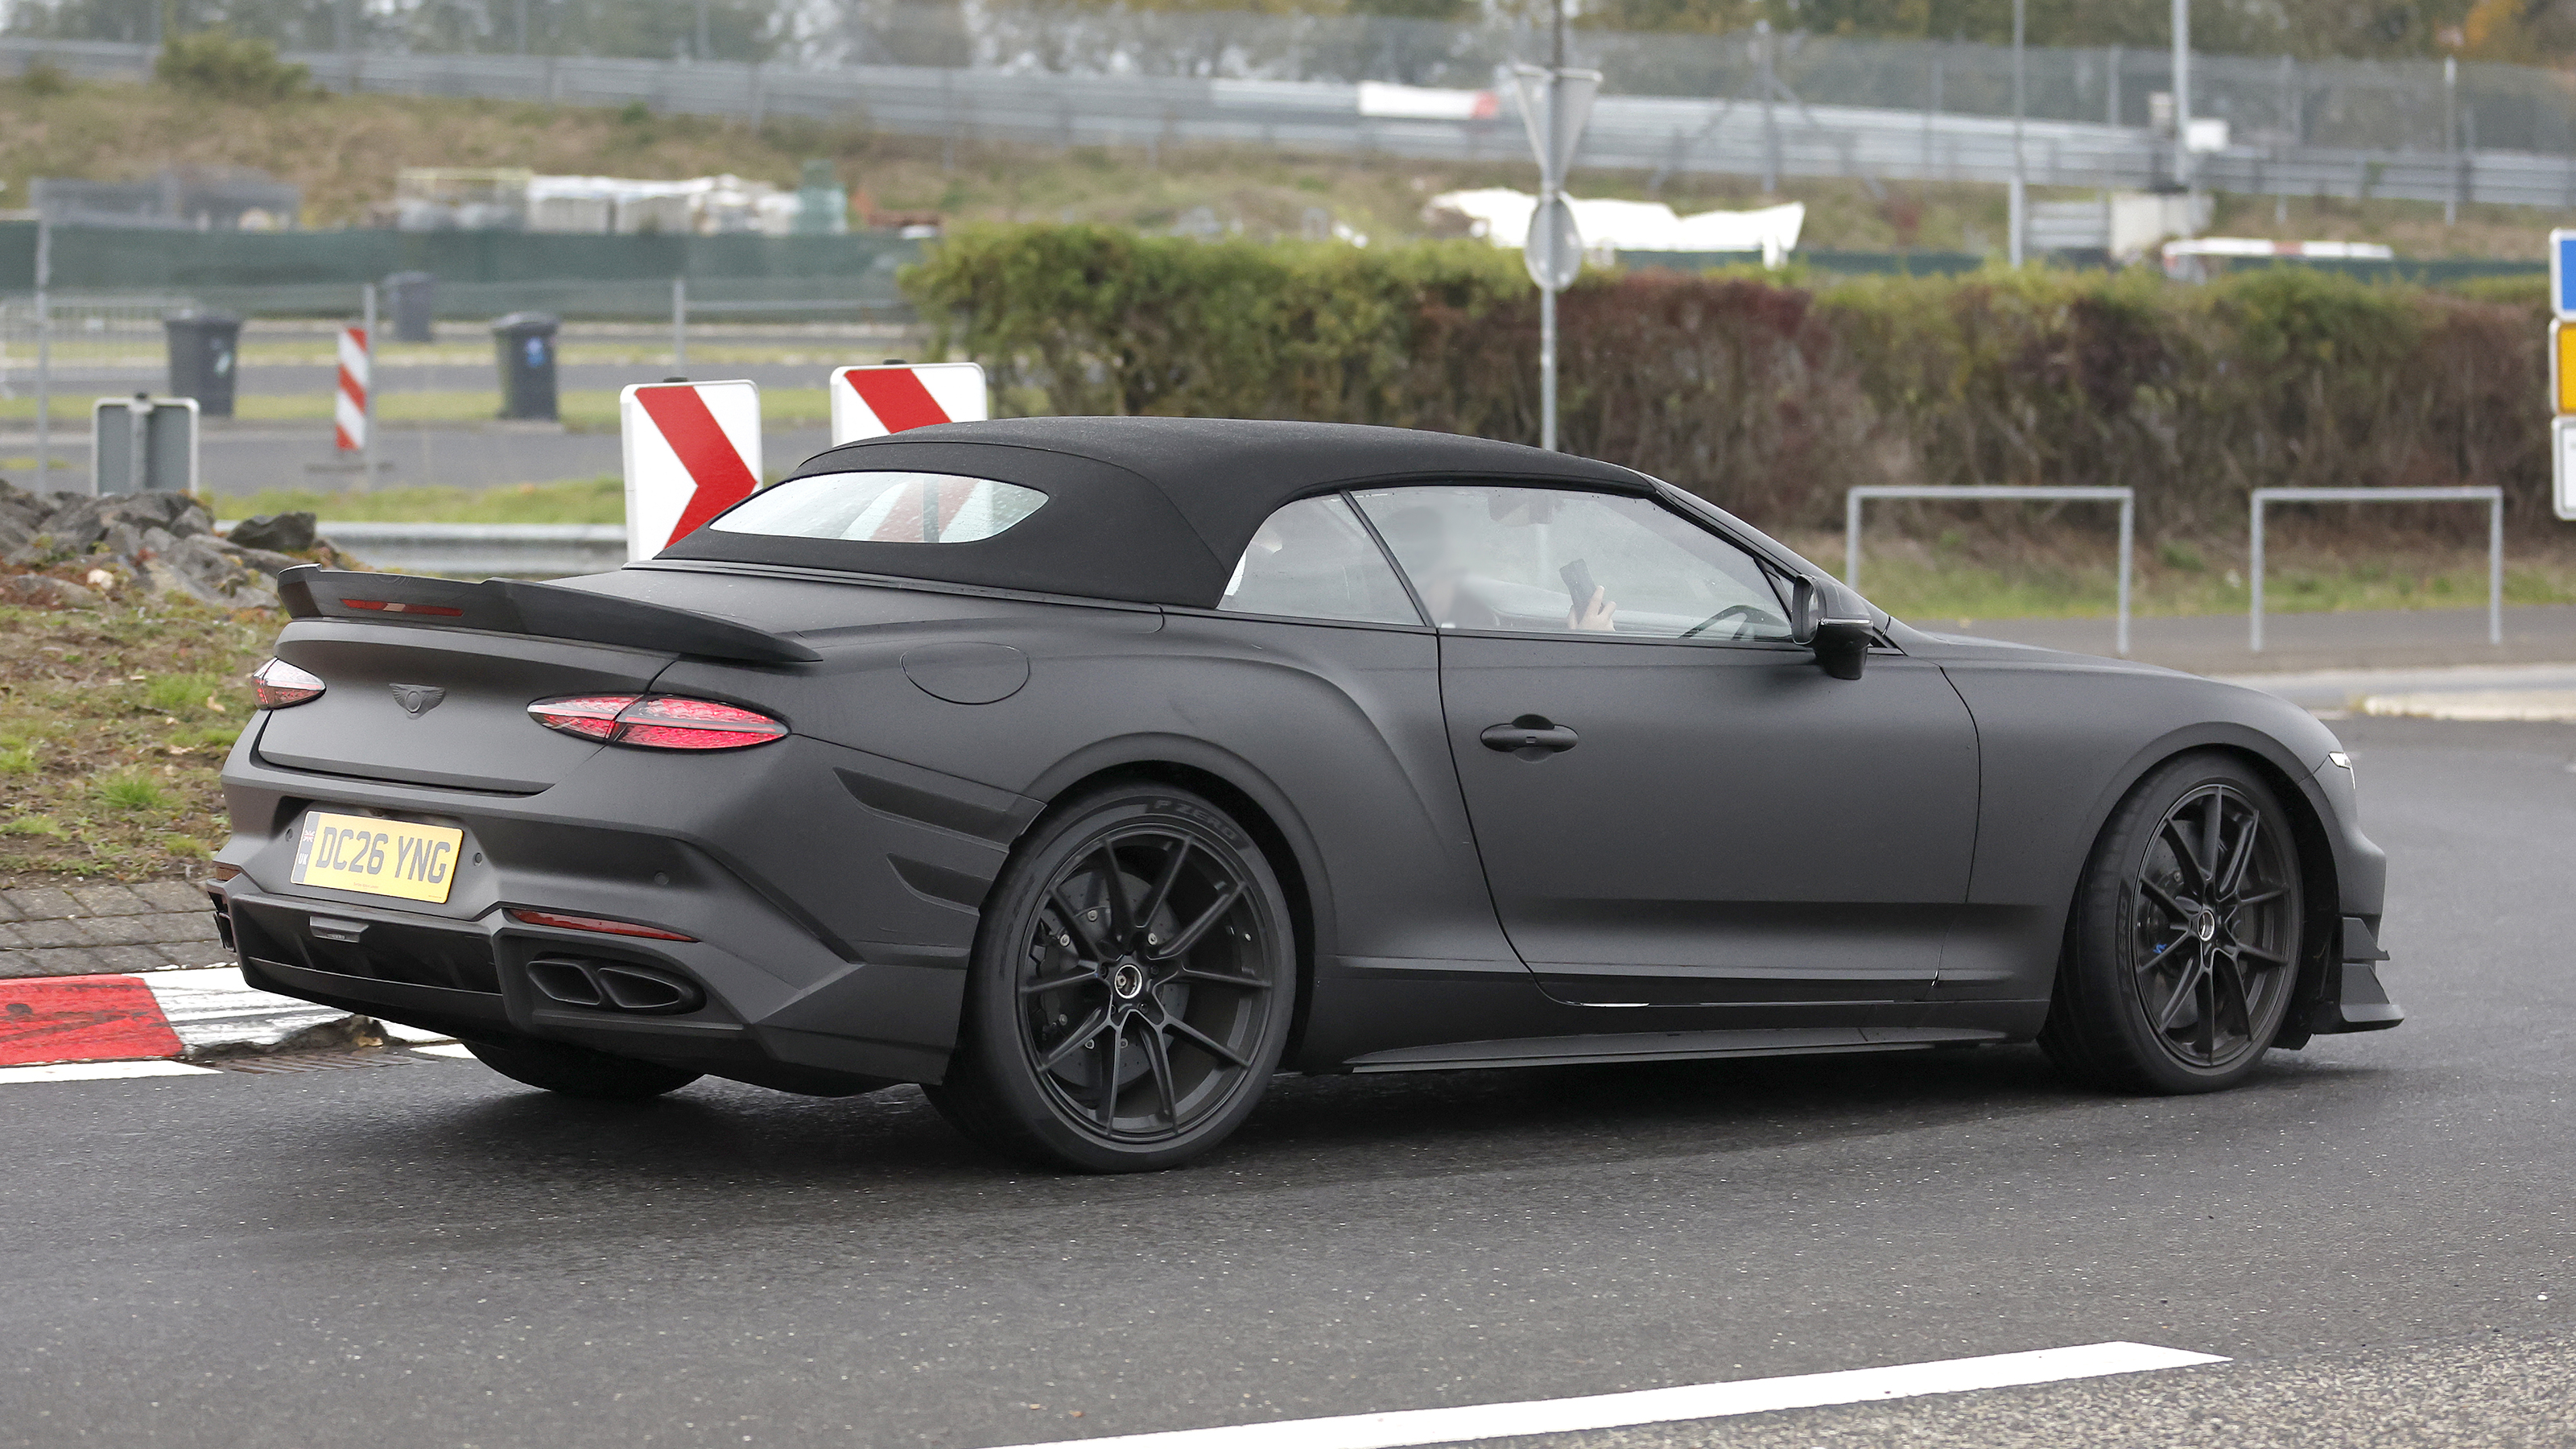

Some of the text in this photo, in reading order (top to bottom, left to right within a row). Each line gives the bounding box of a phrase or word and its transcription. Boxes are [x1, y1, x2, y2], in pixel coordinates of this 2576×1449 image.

[298, 852, 309, 865] UK
[316, 827, 451, 884] DC26 YNG
